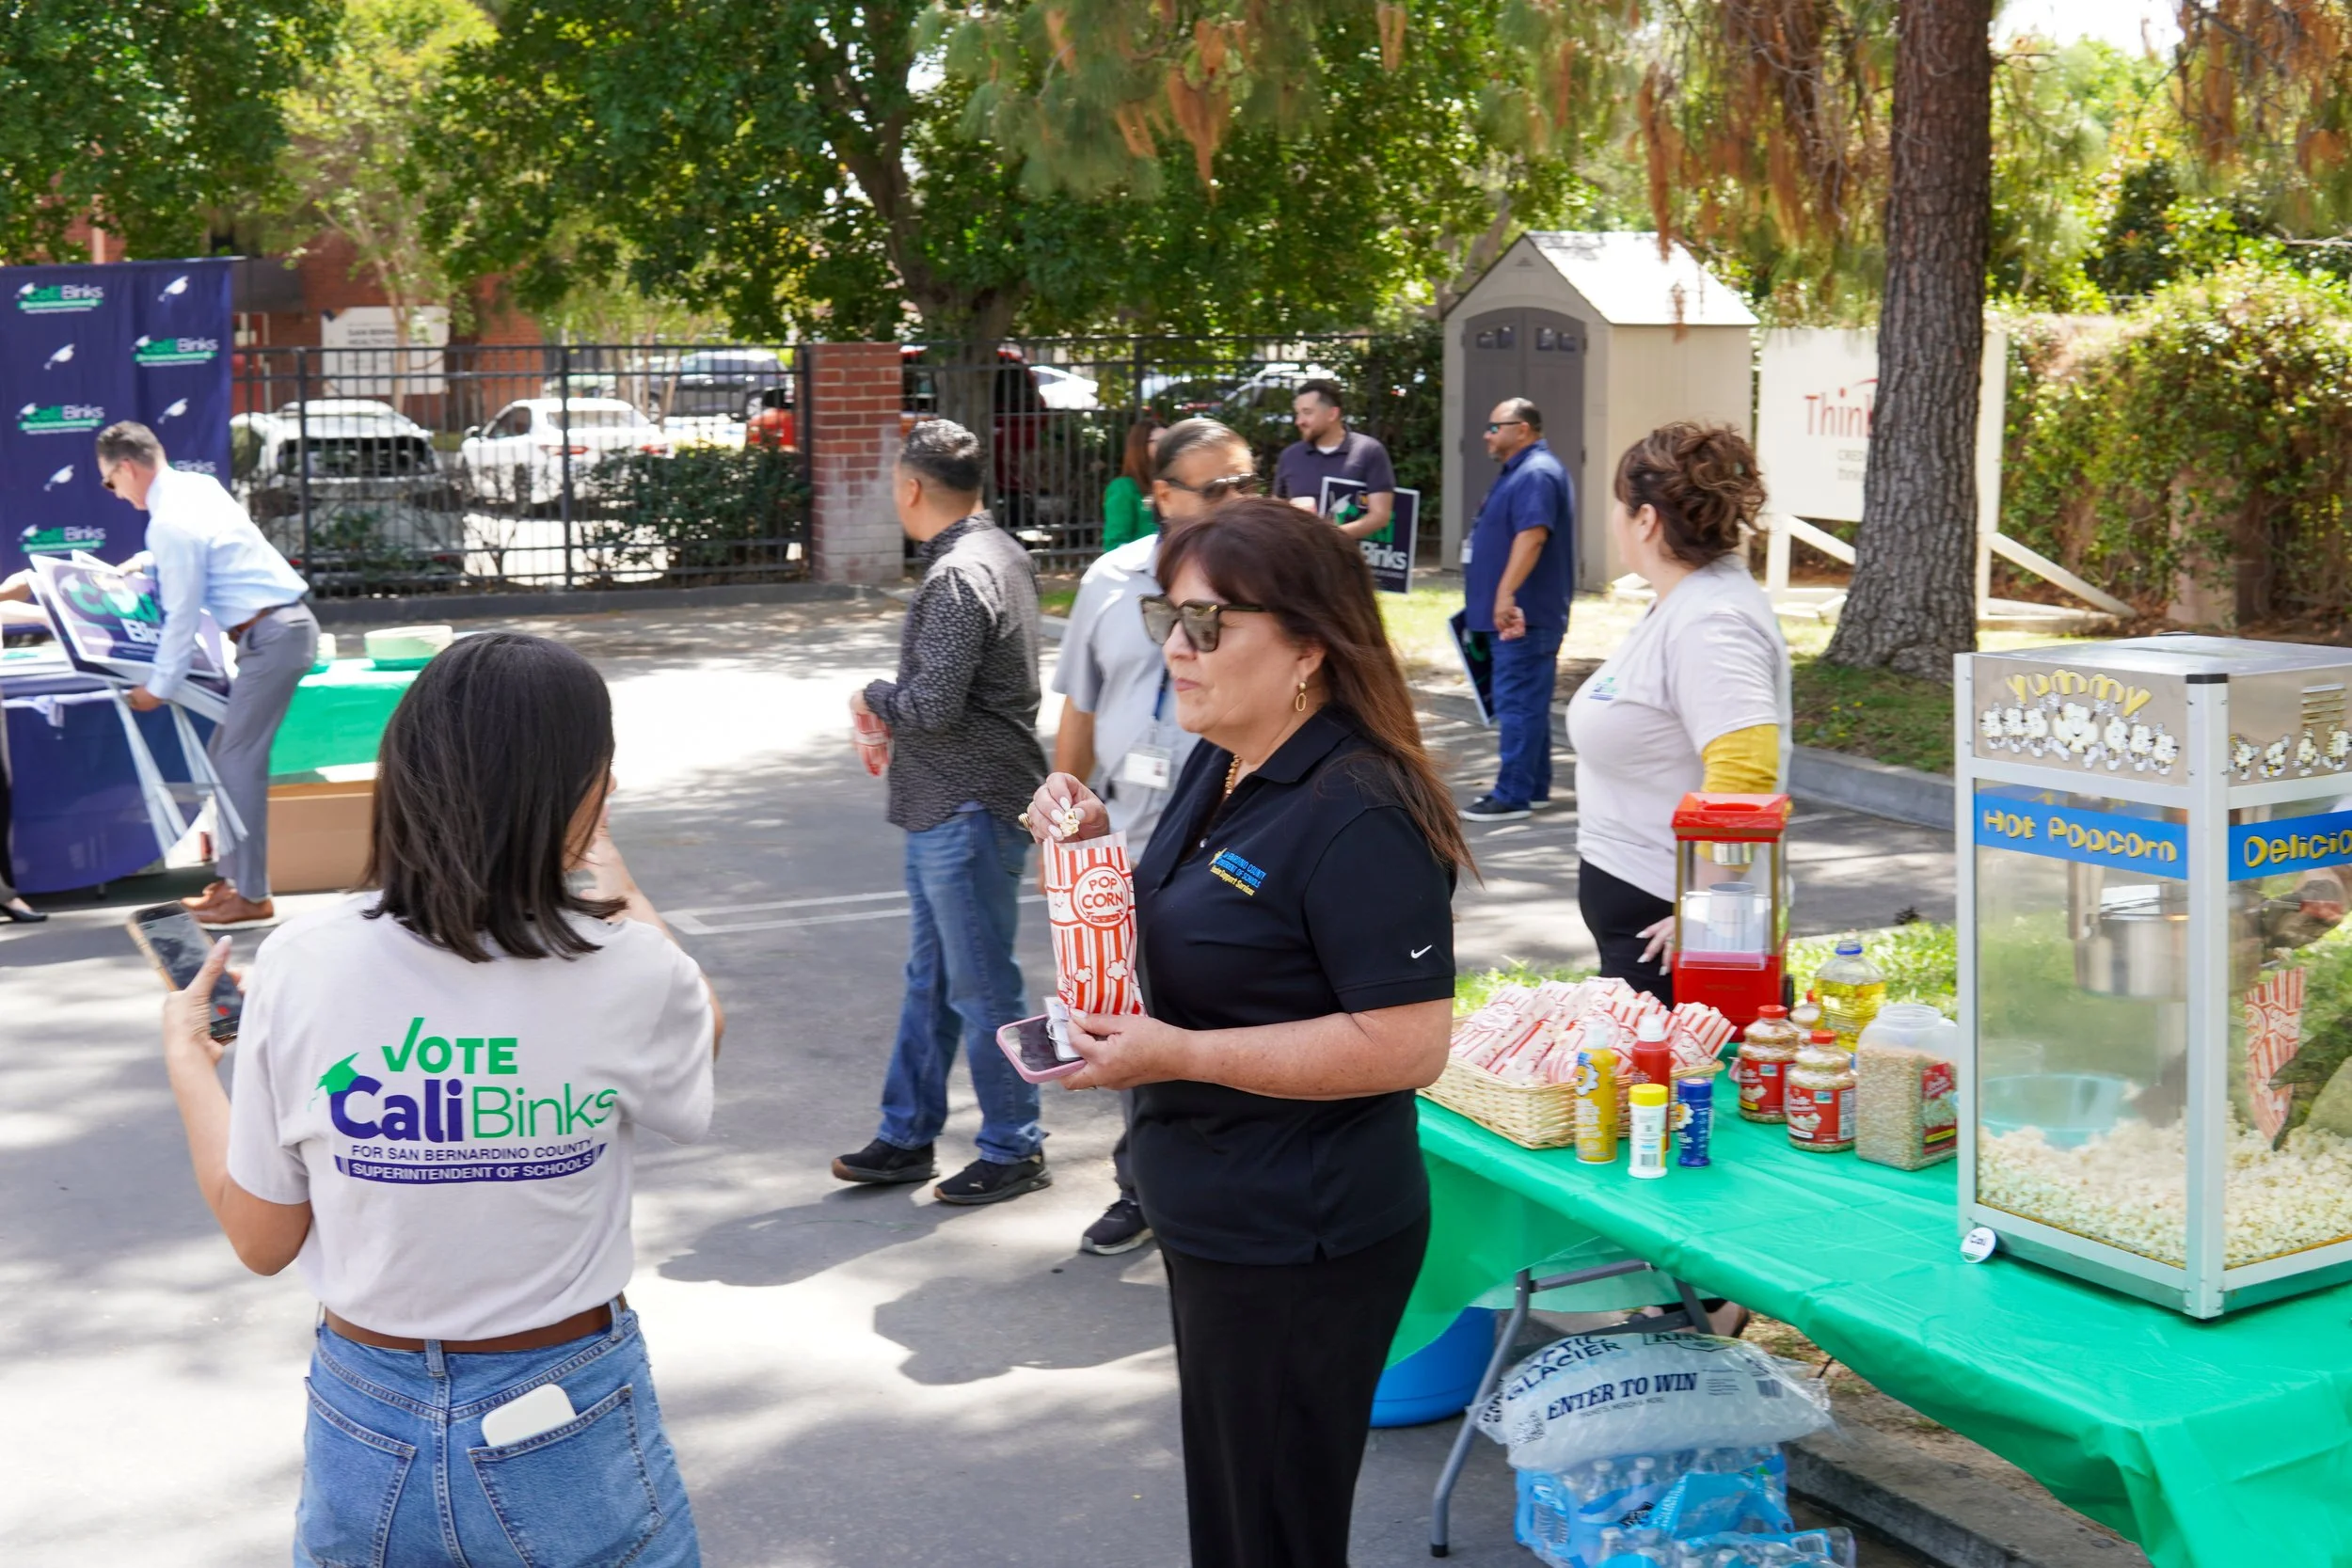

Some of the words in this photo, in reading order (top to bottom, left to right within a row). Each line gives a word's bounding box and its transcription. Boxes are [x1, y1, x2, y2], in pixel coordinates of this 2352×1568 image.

[1983, 809, 2037, 839] Hot
[2048, 816, 2177, 863] Popcorn
[1082, 892, 1124, 909] CORN
[1089, 876, 1118, 891] POP
[381, 1017, 518, 1074] VOTE
[472, 1083, 618, 1139] Binks
[352, 1144, 383, 1158] FOR
[388, 1147, 420, 1161] SAN
[425, 1147, 530, 1162] BERNARDINO
[534, 1137, 594, 1158] COUNTY
[352, 1163, 492, 1180] SUPERINTENDENT
[496, 1165, 519, 1178] OF
[525, 1153, 594, 1178] SCHOOLS
[1546, 1383, 1614, 1420] ENTER
[1619, 1377, 1648, 1398] TO
[1654, 1372, 1698, 1392] WIN
